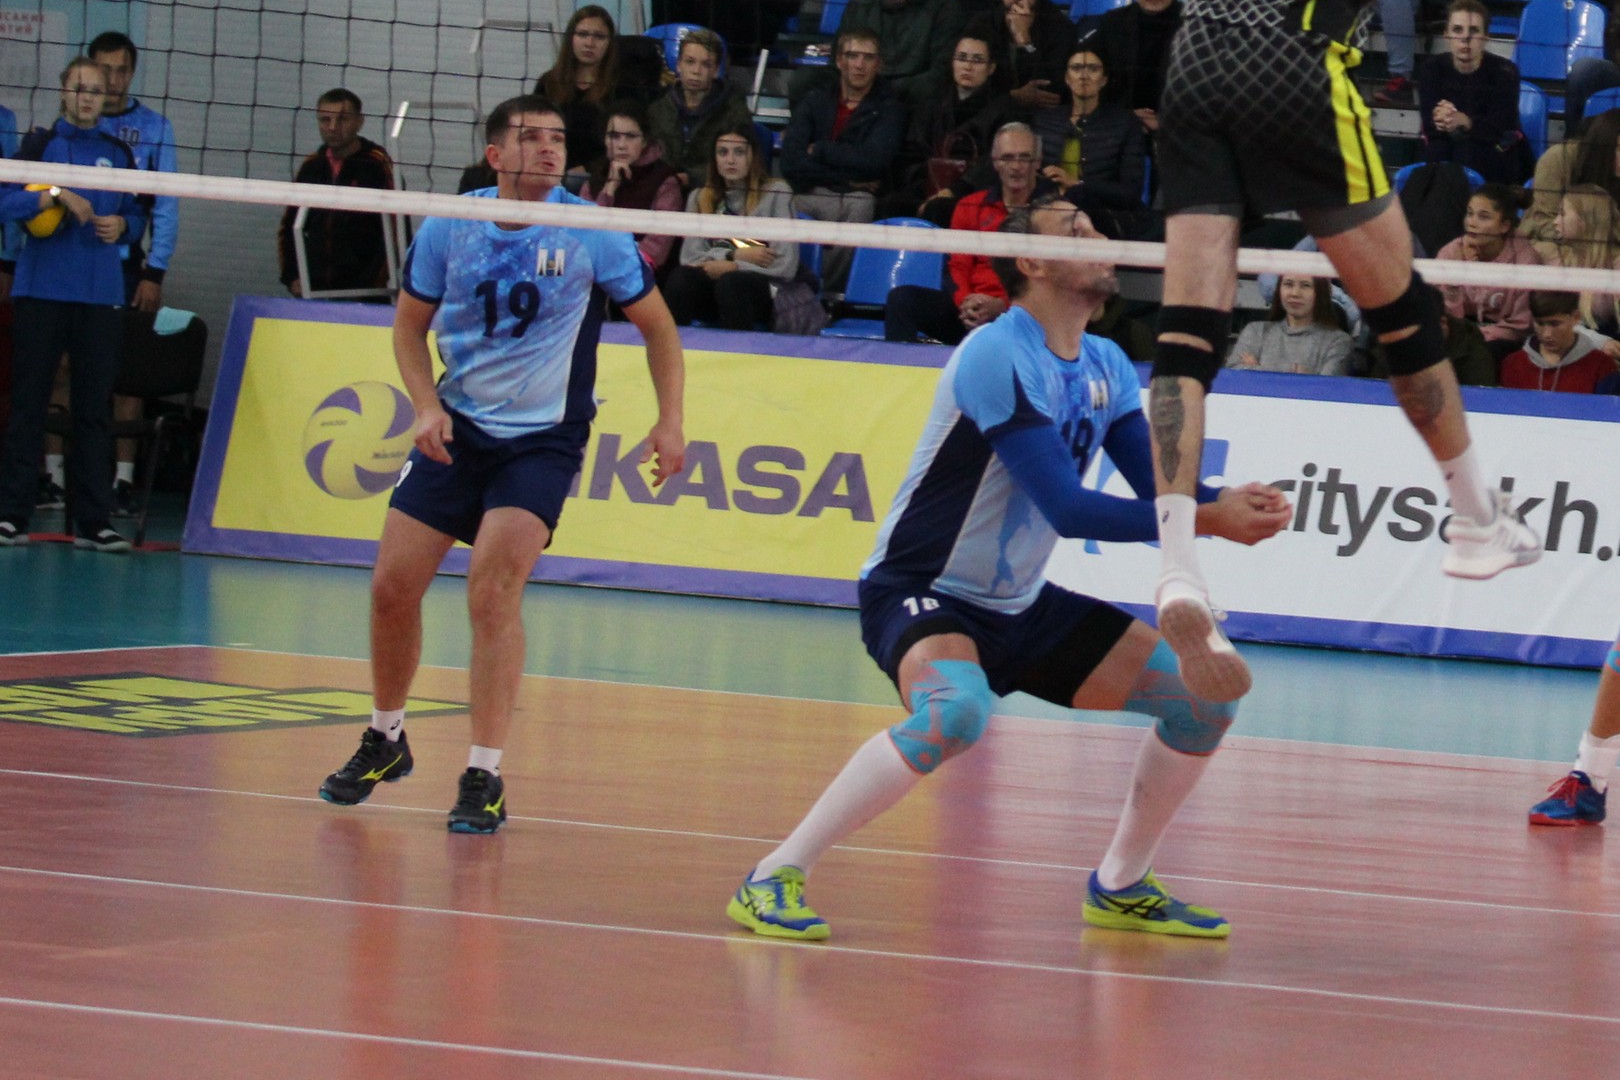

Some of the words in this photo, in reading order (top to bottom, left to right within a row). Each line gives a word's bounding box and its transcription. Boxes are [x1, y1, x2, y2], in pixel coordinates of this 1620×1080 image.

[475, 280, 540, 338] 19
[568, 432, 876, 523] KASA
[902, 595, 941, 617] 18
